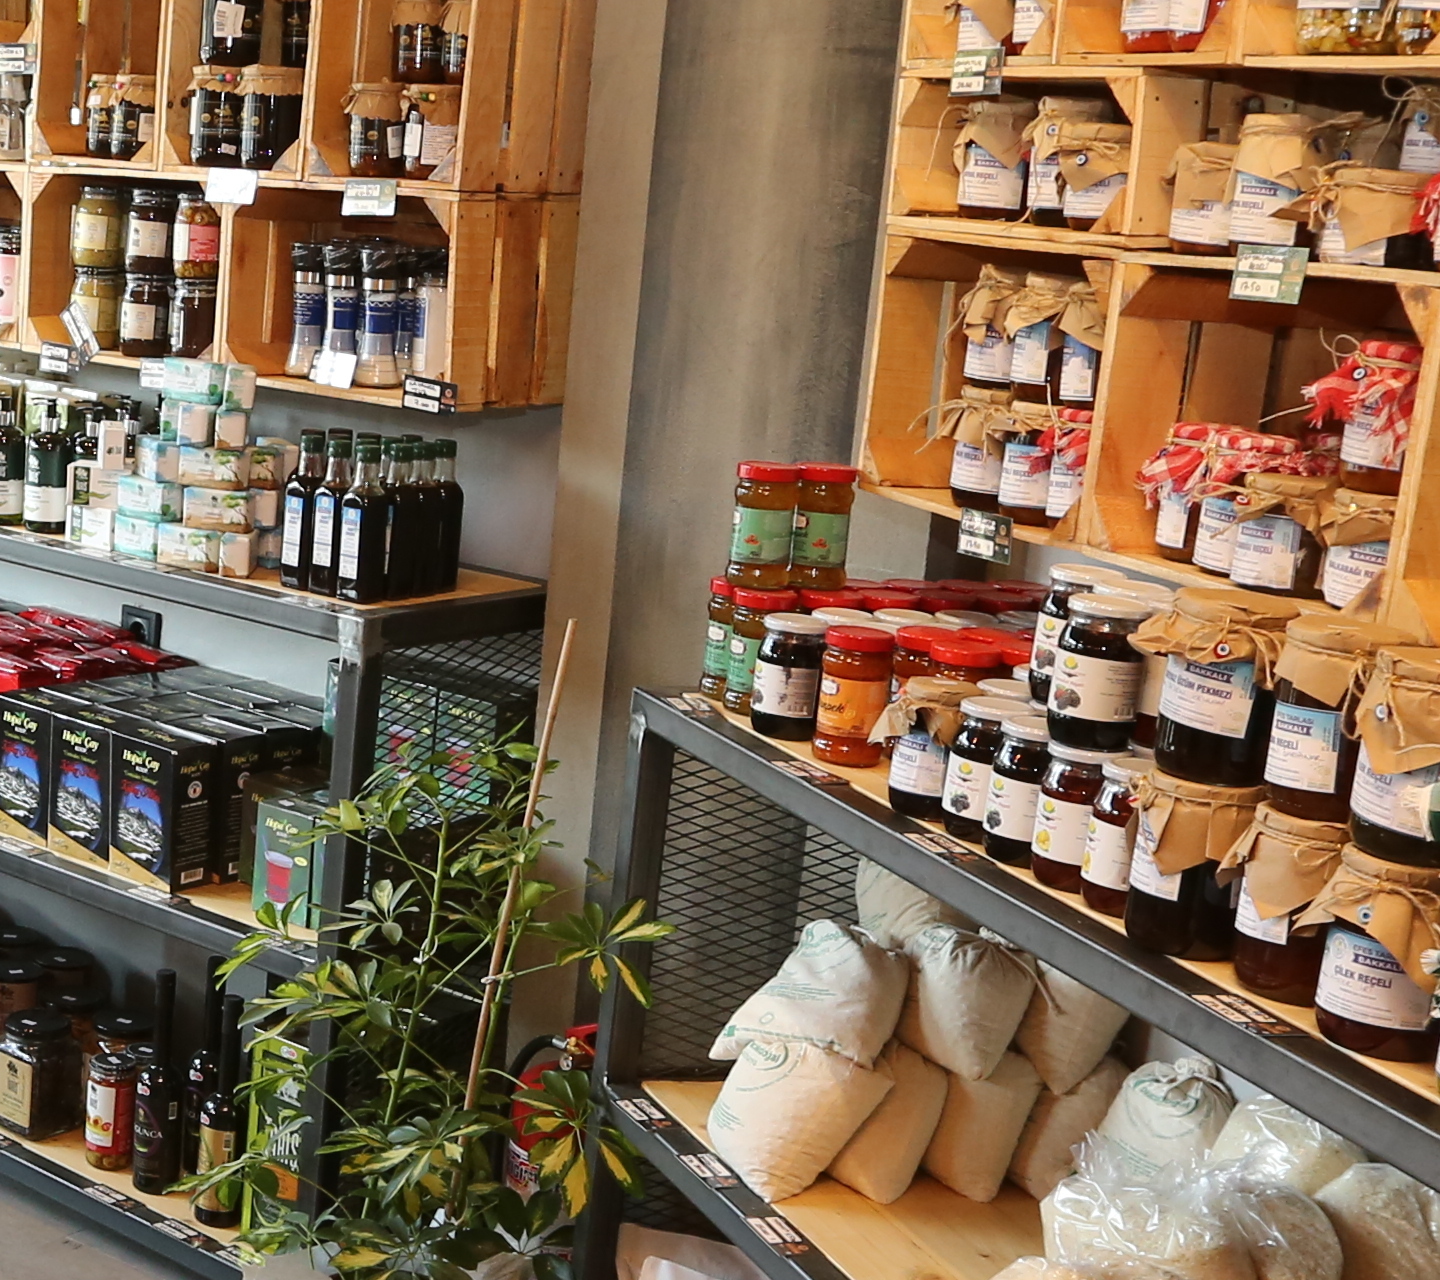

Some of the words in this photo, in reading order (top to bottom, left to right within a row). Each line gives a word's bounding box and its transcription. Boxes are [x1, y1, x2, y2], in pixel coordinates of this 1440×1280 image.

[1196, 683, 1232, 700] PEKMEZİ
[3, 710, 21, 728] Hopa
[19, 716, 38, 732] Çay
[62, 728, 82, 746] Hopa
[81, 736, 100, 752] Çay
[122, 749, 142, 766] Hopa
[140, 756, 160, 772] Çay
[1357, 956, 1402, 972] BAKKALI
[1334, 965, 1356, 981] ÇİLEK
[1357, 974, 1392, 989] REÇELİ
